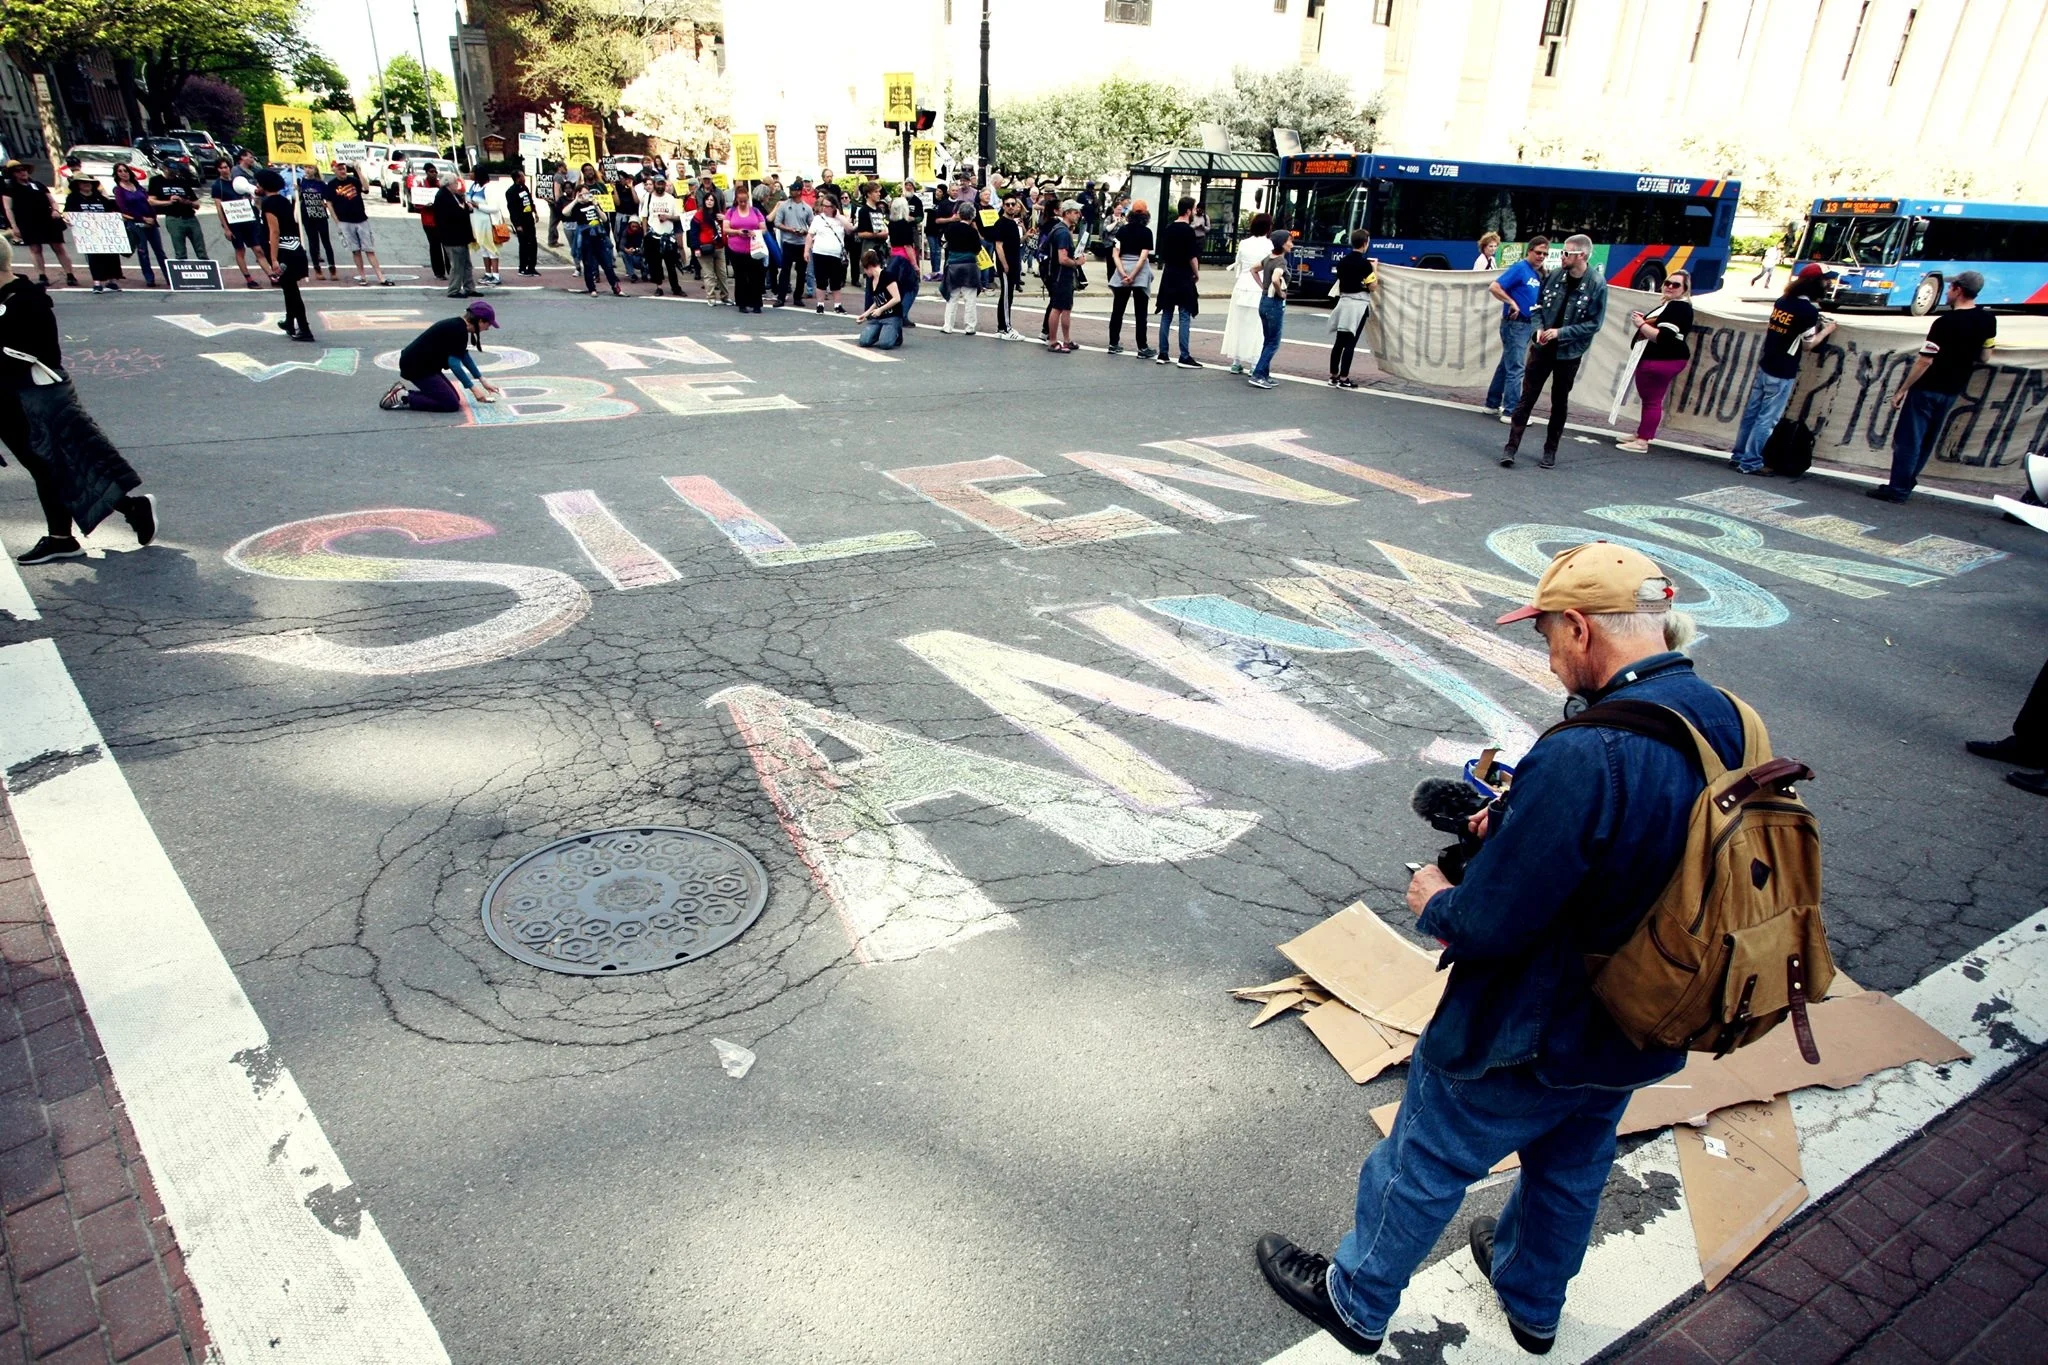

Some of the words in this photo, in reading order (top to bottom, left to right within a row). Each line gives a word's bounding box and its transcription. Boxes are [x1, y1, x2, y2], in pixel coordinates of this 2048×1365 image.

[336, 148, 365, 156] Suppression
[1406, 165, 1420, 173] 4099
[1826, 202, 1838, 213] 13
[75, 220, 120, 229] CONTRY
[75, 236, 104, 244] MY
[1372, 242, 1404, 250] www.cdta.org
[152, 308, 435, 338] WE
[198, 333, 900, 384] WON'T
[454, 372, 811, 430] BE
[164, 427, 1471, 677] SILENT
[704, 484, 2011, 964] ANYMORE
